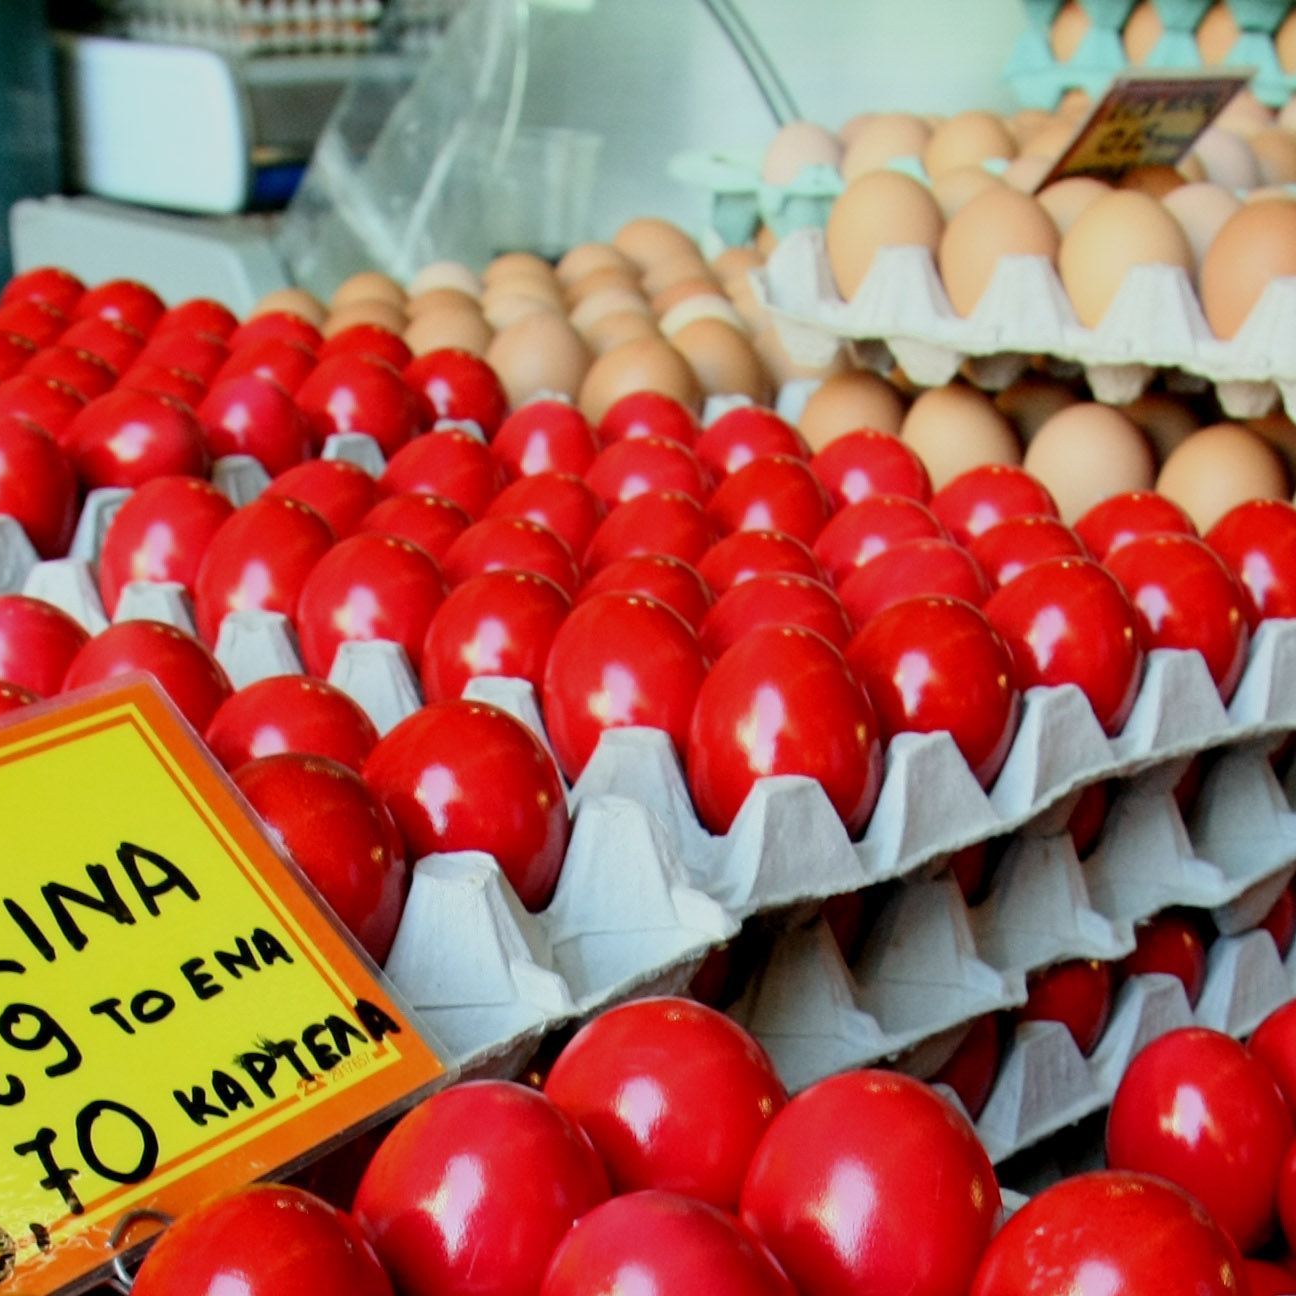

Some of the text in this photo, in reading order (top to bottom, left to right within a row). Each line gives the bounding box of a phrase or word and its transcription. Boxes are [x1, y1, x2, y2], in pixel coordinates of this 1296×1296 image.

[90, 989, 176, 1035] ΤΟ
[180, 928, 294, 1001] ΕΝΑ
[172, 998, 402, 1127] ΚΑΡΤΕΛΑ
